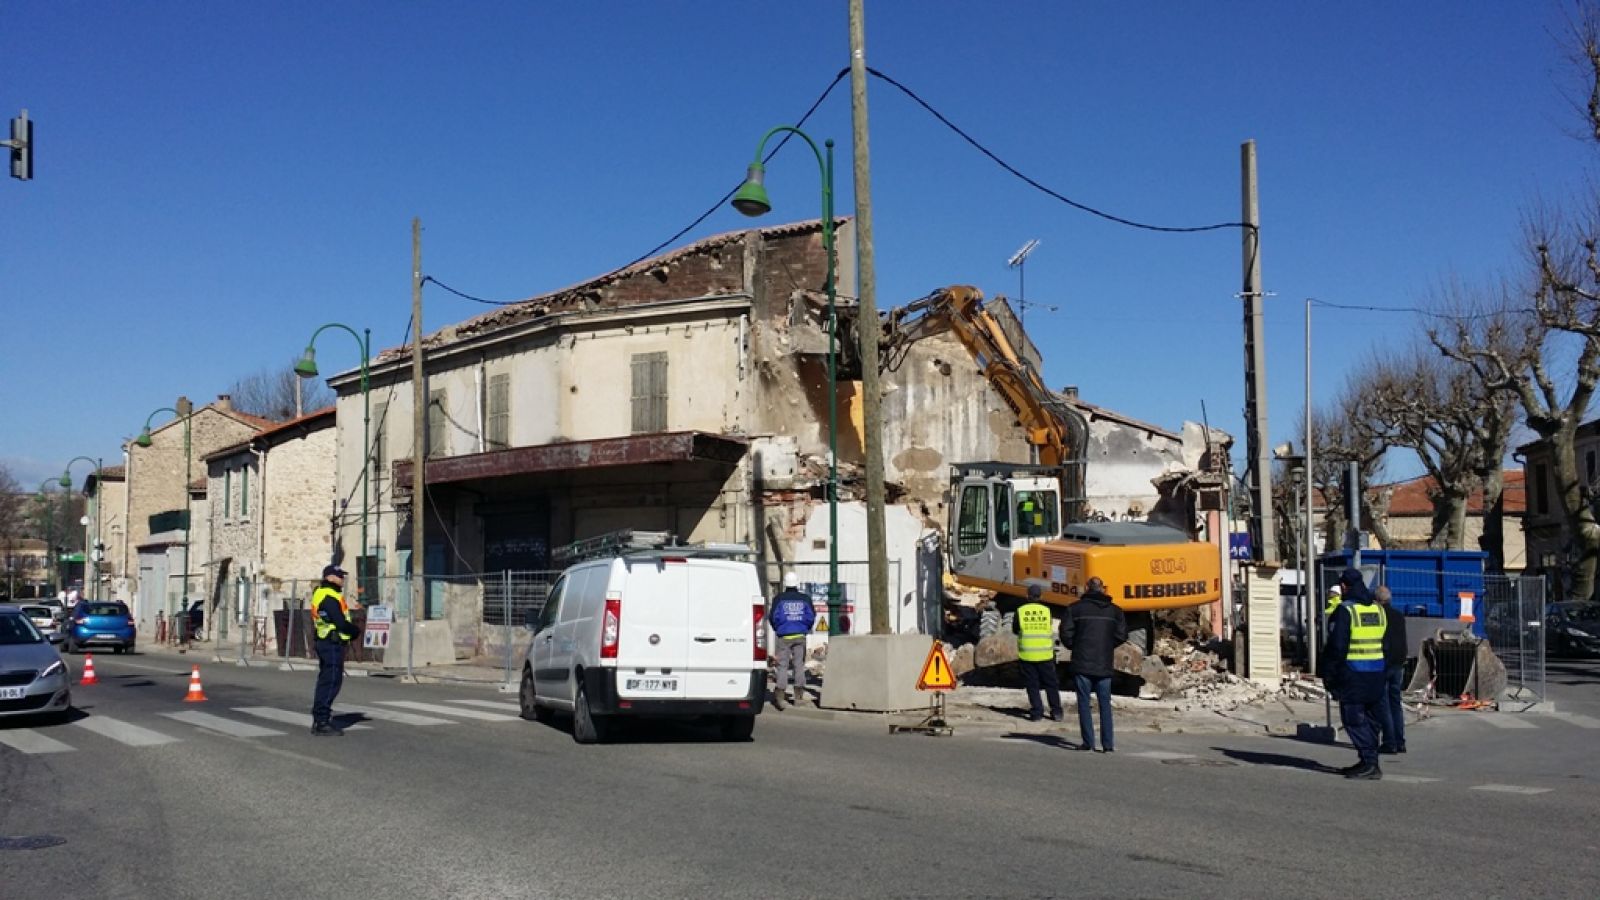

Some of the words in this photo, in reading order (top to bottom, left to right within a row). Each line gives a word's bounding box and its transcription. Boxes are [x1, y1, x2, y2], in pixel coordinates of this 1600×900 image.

[1150, 558, 1186, 575] 904
[1051, 582, 1078, 595] 904
[1123, 580, 1207, 599] LIEBHERR
